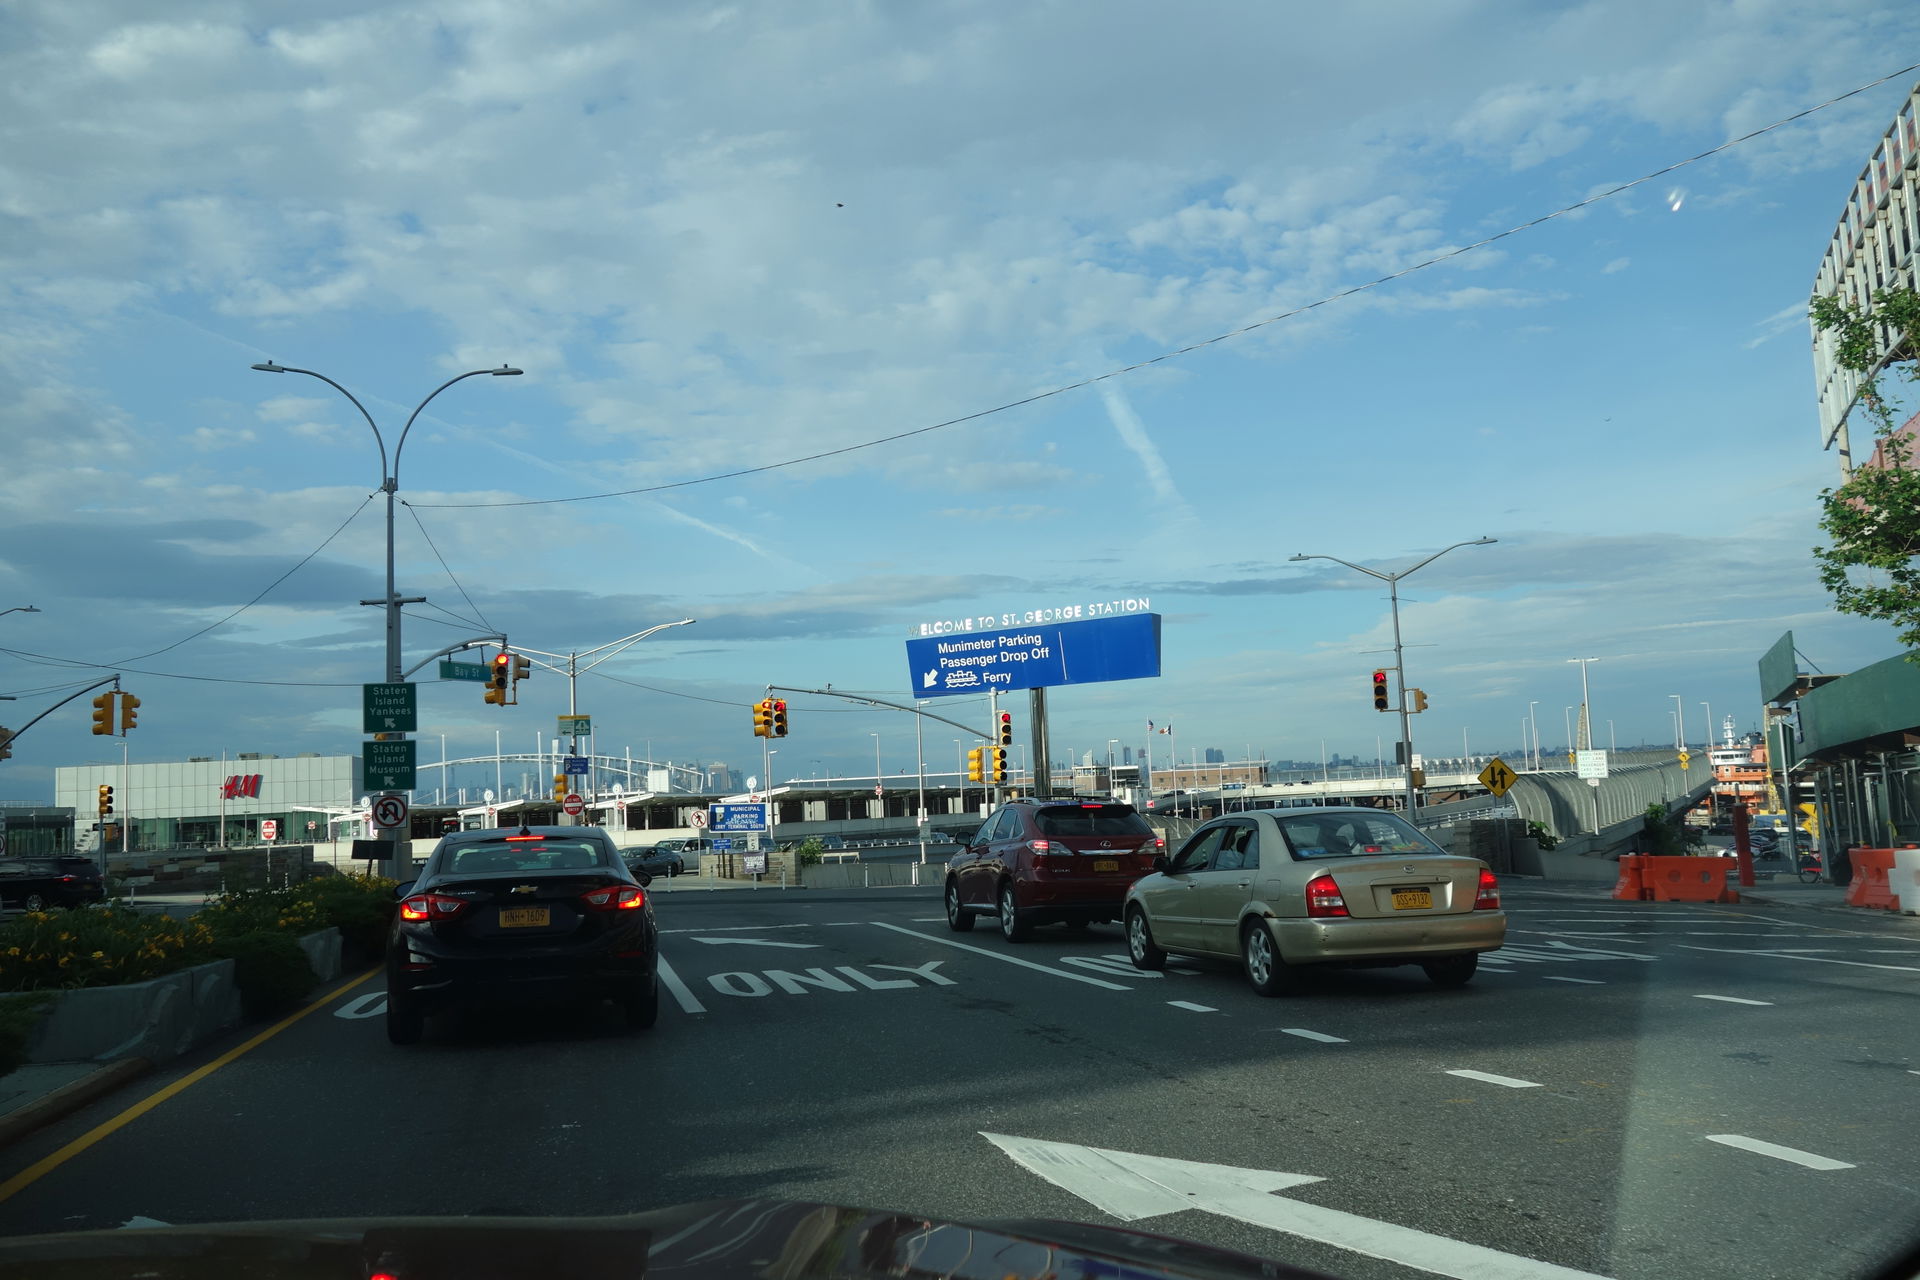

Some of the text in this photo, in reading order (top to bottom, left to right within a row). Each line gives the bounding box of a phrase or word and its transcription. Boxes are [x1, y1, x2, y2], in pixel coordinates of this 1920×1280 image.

[978, 616, 995, 629] TO
[1001, 613, 1021, 626] ST.
[1024, 605, 1082, 623] GEORGE
[1088, 598, 1151, 616] STATION
[938, 633, 1042, 654] Munimeter Parking
[939, 647, 1050, 669] Passenger Drop Off
[455, 666, 480, 678] Bay St
[982, 671, 1012, 685] Ferry
[373, 687, 407, 695] Staten
[375, 697, 405, 705] Island
[370, 707, 412, 716] Yankees
[372, 744, 407, 753] Staten
[374, 754, 405, 763] Island
[369, 765, 410, 774] Museum
[707, 960, 957, 998] ONLY
